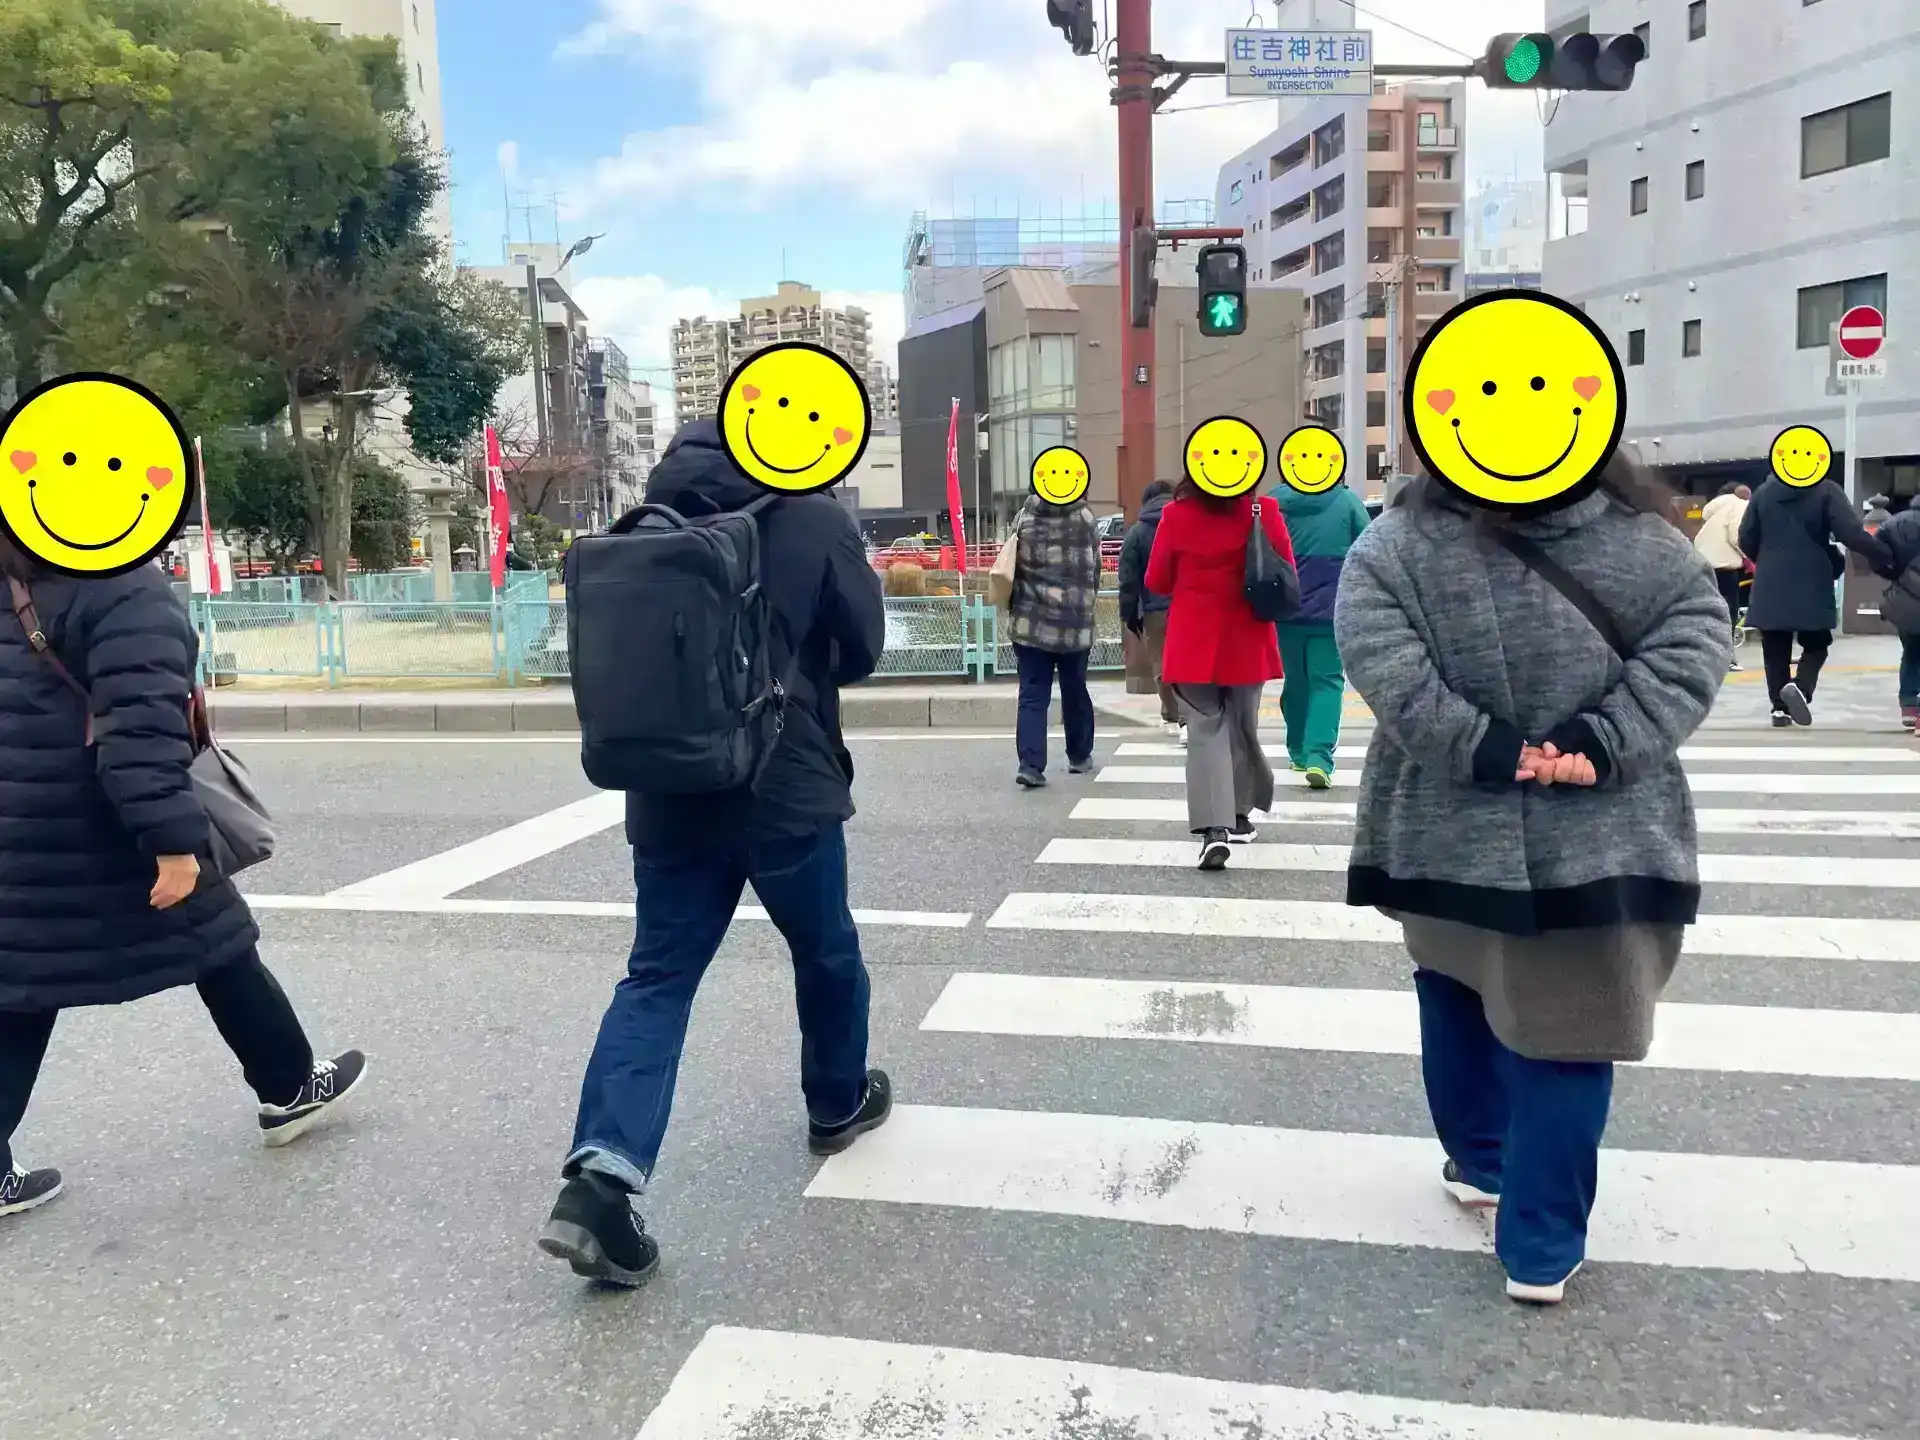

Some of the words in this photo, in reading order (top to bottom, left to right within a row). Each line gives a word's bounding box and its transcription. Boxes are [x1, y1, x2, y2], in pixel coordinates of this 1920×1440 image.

[1233, 36, 1365, 62] 住吉神社前
[1249, 65, 1308, 79] Sumiyoshi
[1314, 66, 1351, 79] Shrine
[1267, 81, 1334, 90] INTERSECTION
[312, 1073, 334, 1102] N
